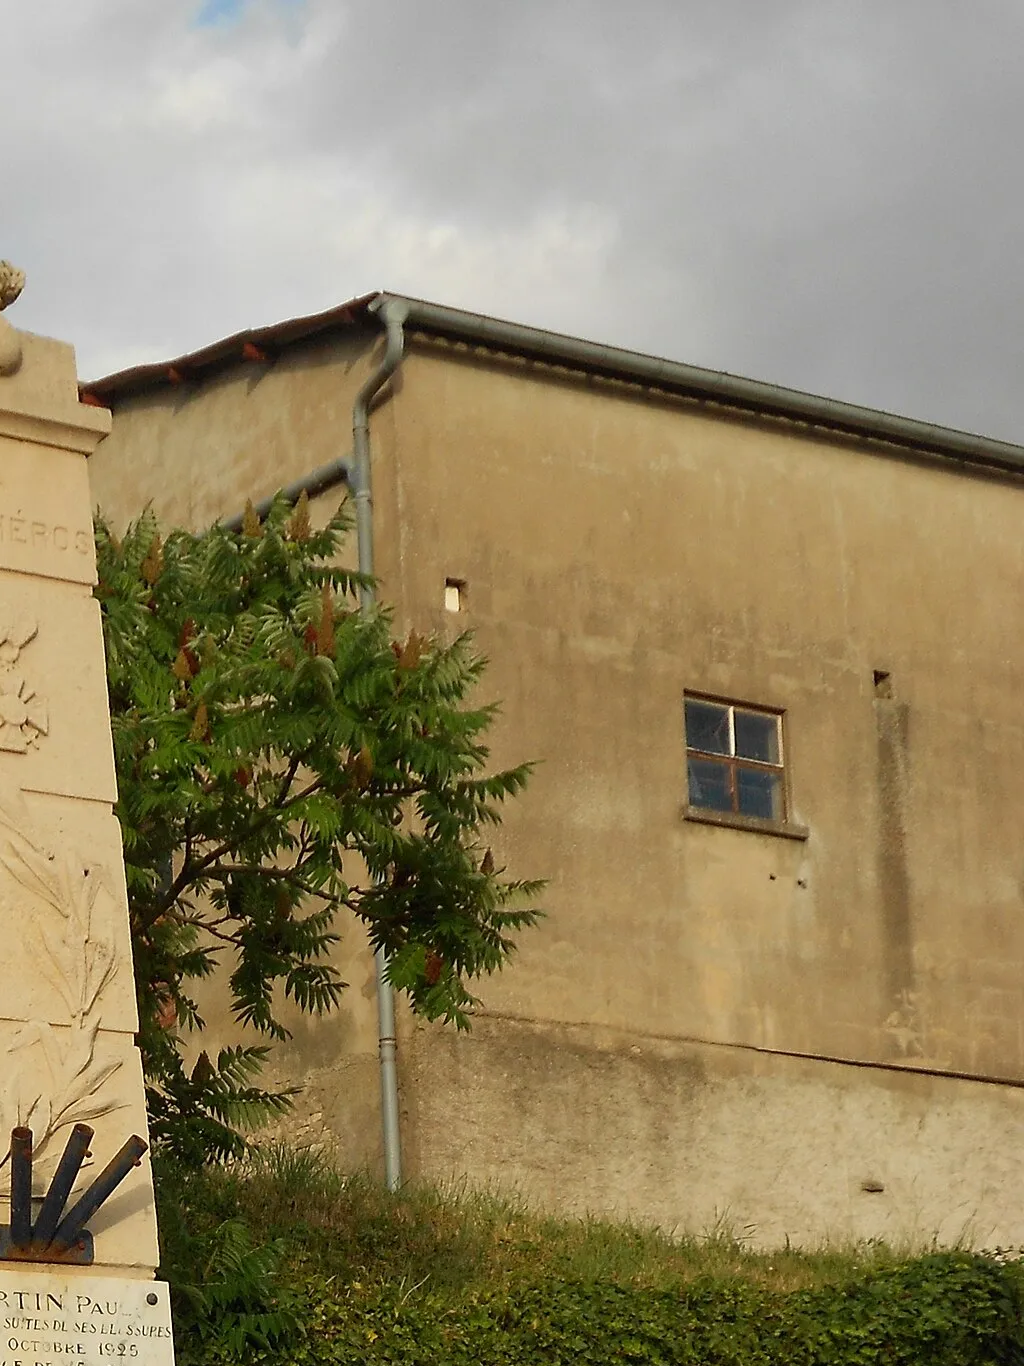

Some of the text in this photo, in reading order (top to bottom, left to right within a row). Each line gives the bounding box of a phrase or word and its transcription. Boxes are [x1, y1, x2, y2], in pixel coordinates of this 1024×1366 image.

[100, 1324, 171, 1338] BLSSURES
[8, 1338, 86, 1355] OCTOBRE
[98, 1343, 138, 1357] 1925
